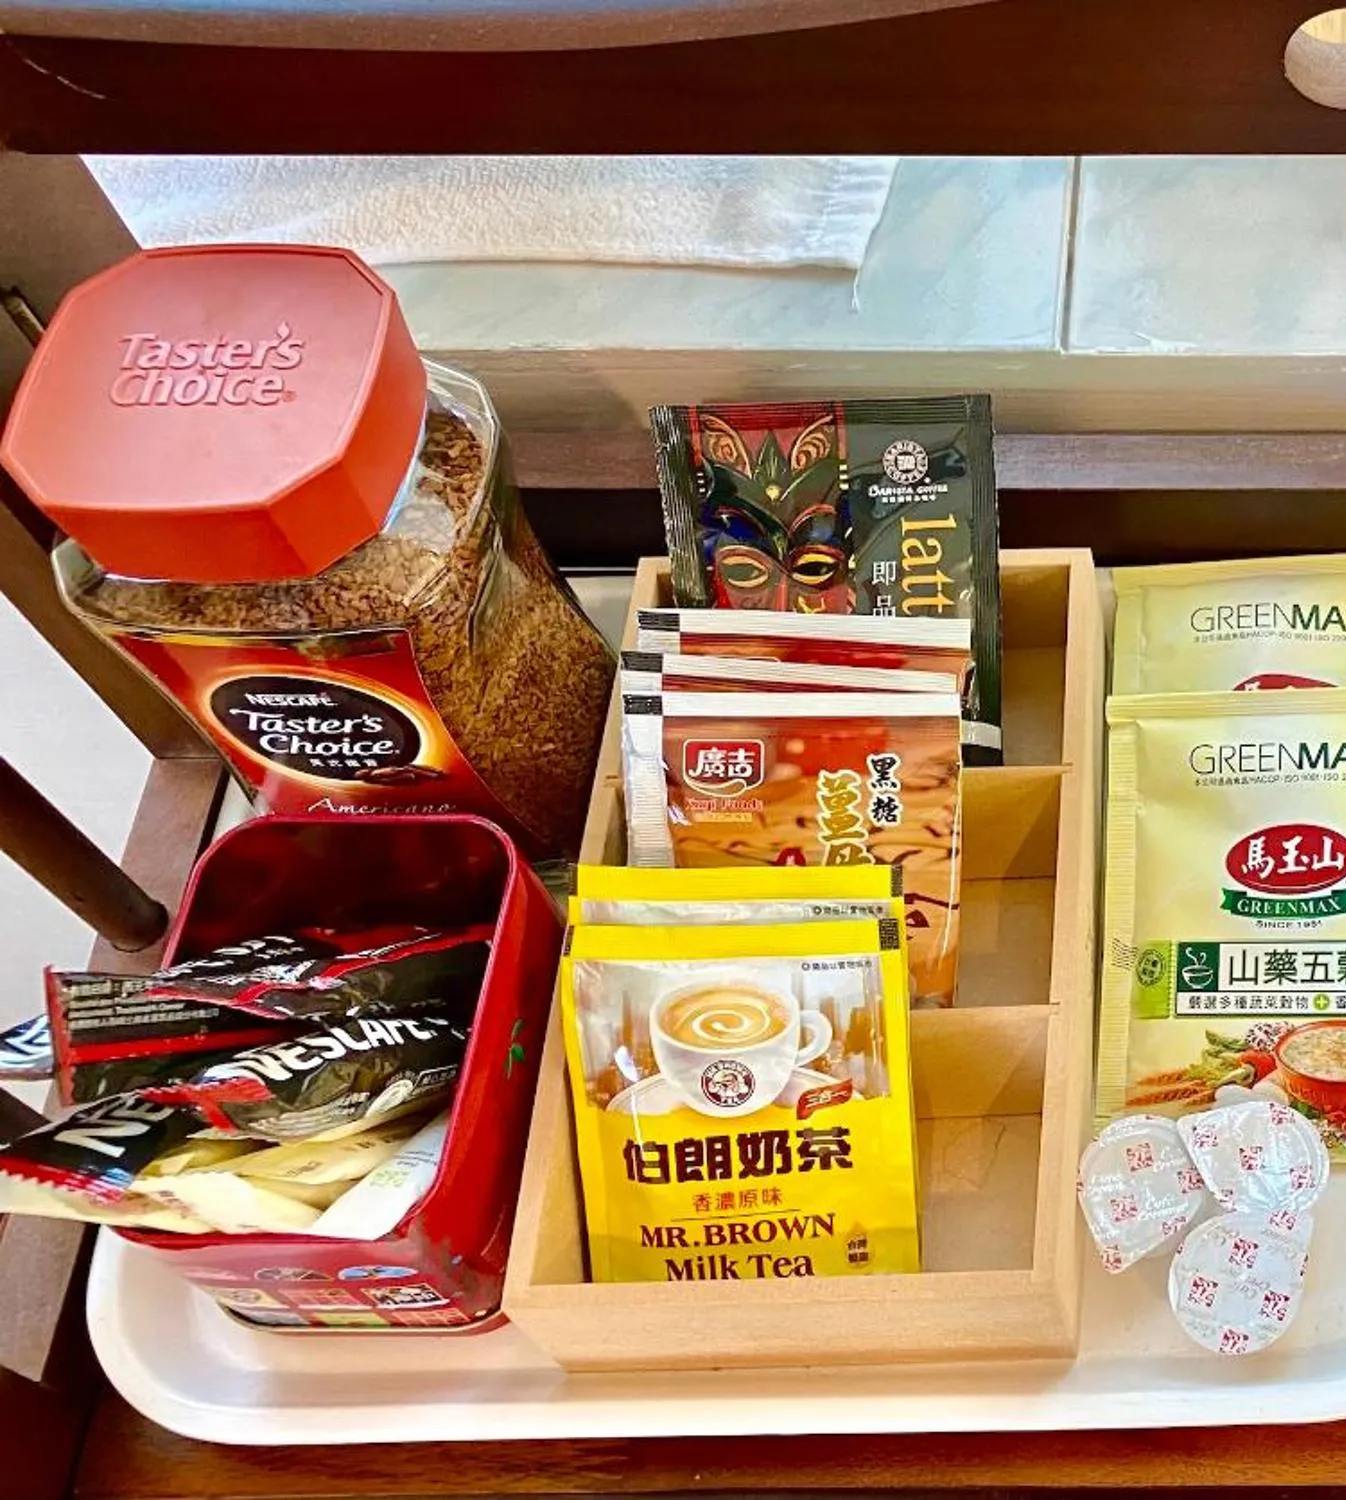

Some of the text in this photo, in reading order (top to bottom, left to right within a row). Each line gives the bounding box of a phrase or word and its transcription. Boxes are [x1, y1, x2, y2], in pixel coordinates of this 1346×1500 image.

[118, 321, 304, 370] Taster's
[109, 369, 285, 407] Choice
[229, 708, 384, 734] Taster's
[259, 733, 395, 755] Choice
[688, 746, 756, 778] 廣吉
[307, 797, 456, 813] Americano
[872, 756, 899, 824] 黑糖
[1241, 835, 1345, 880] 馬玉山
[1236, 897, 1341, 915] GREENMAX
[622, 1126, 854, 1184] 伯朗奶茶
[692, 1186, 784, 1213] 香濃原味
[664, 1253, 816, 1281] Milk Tea
